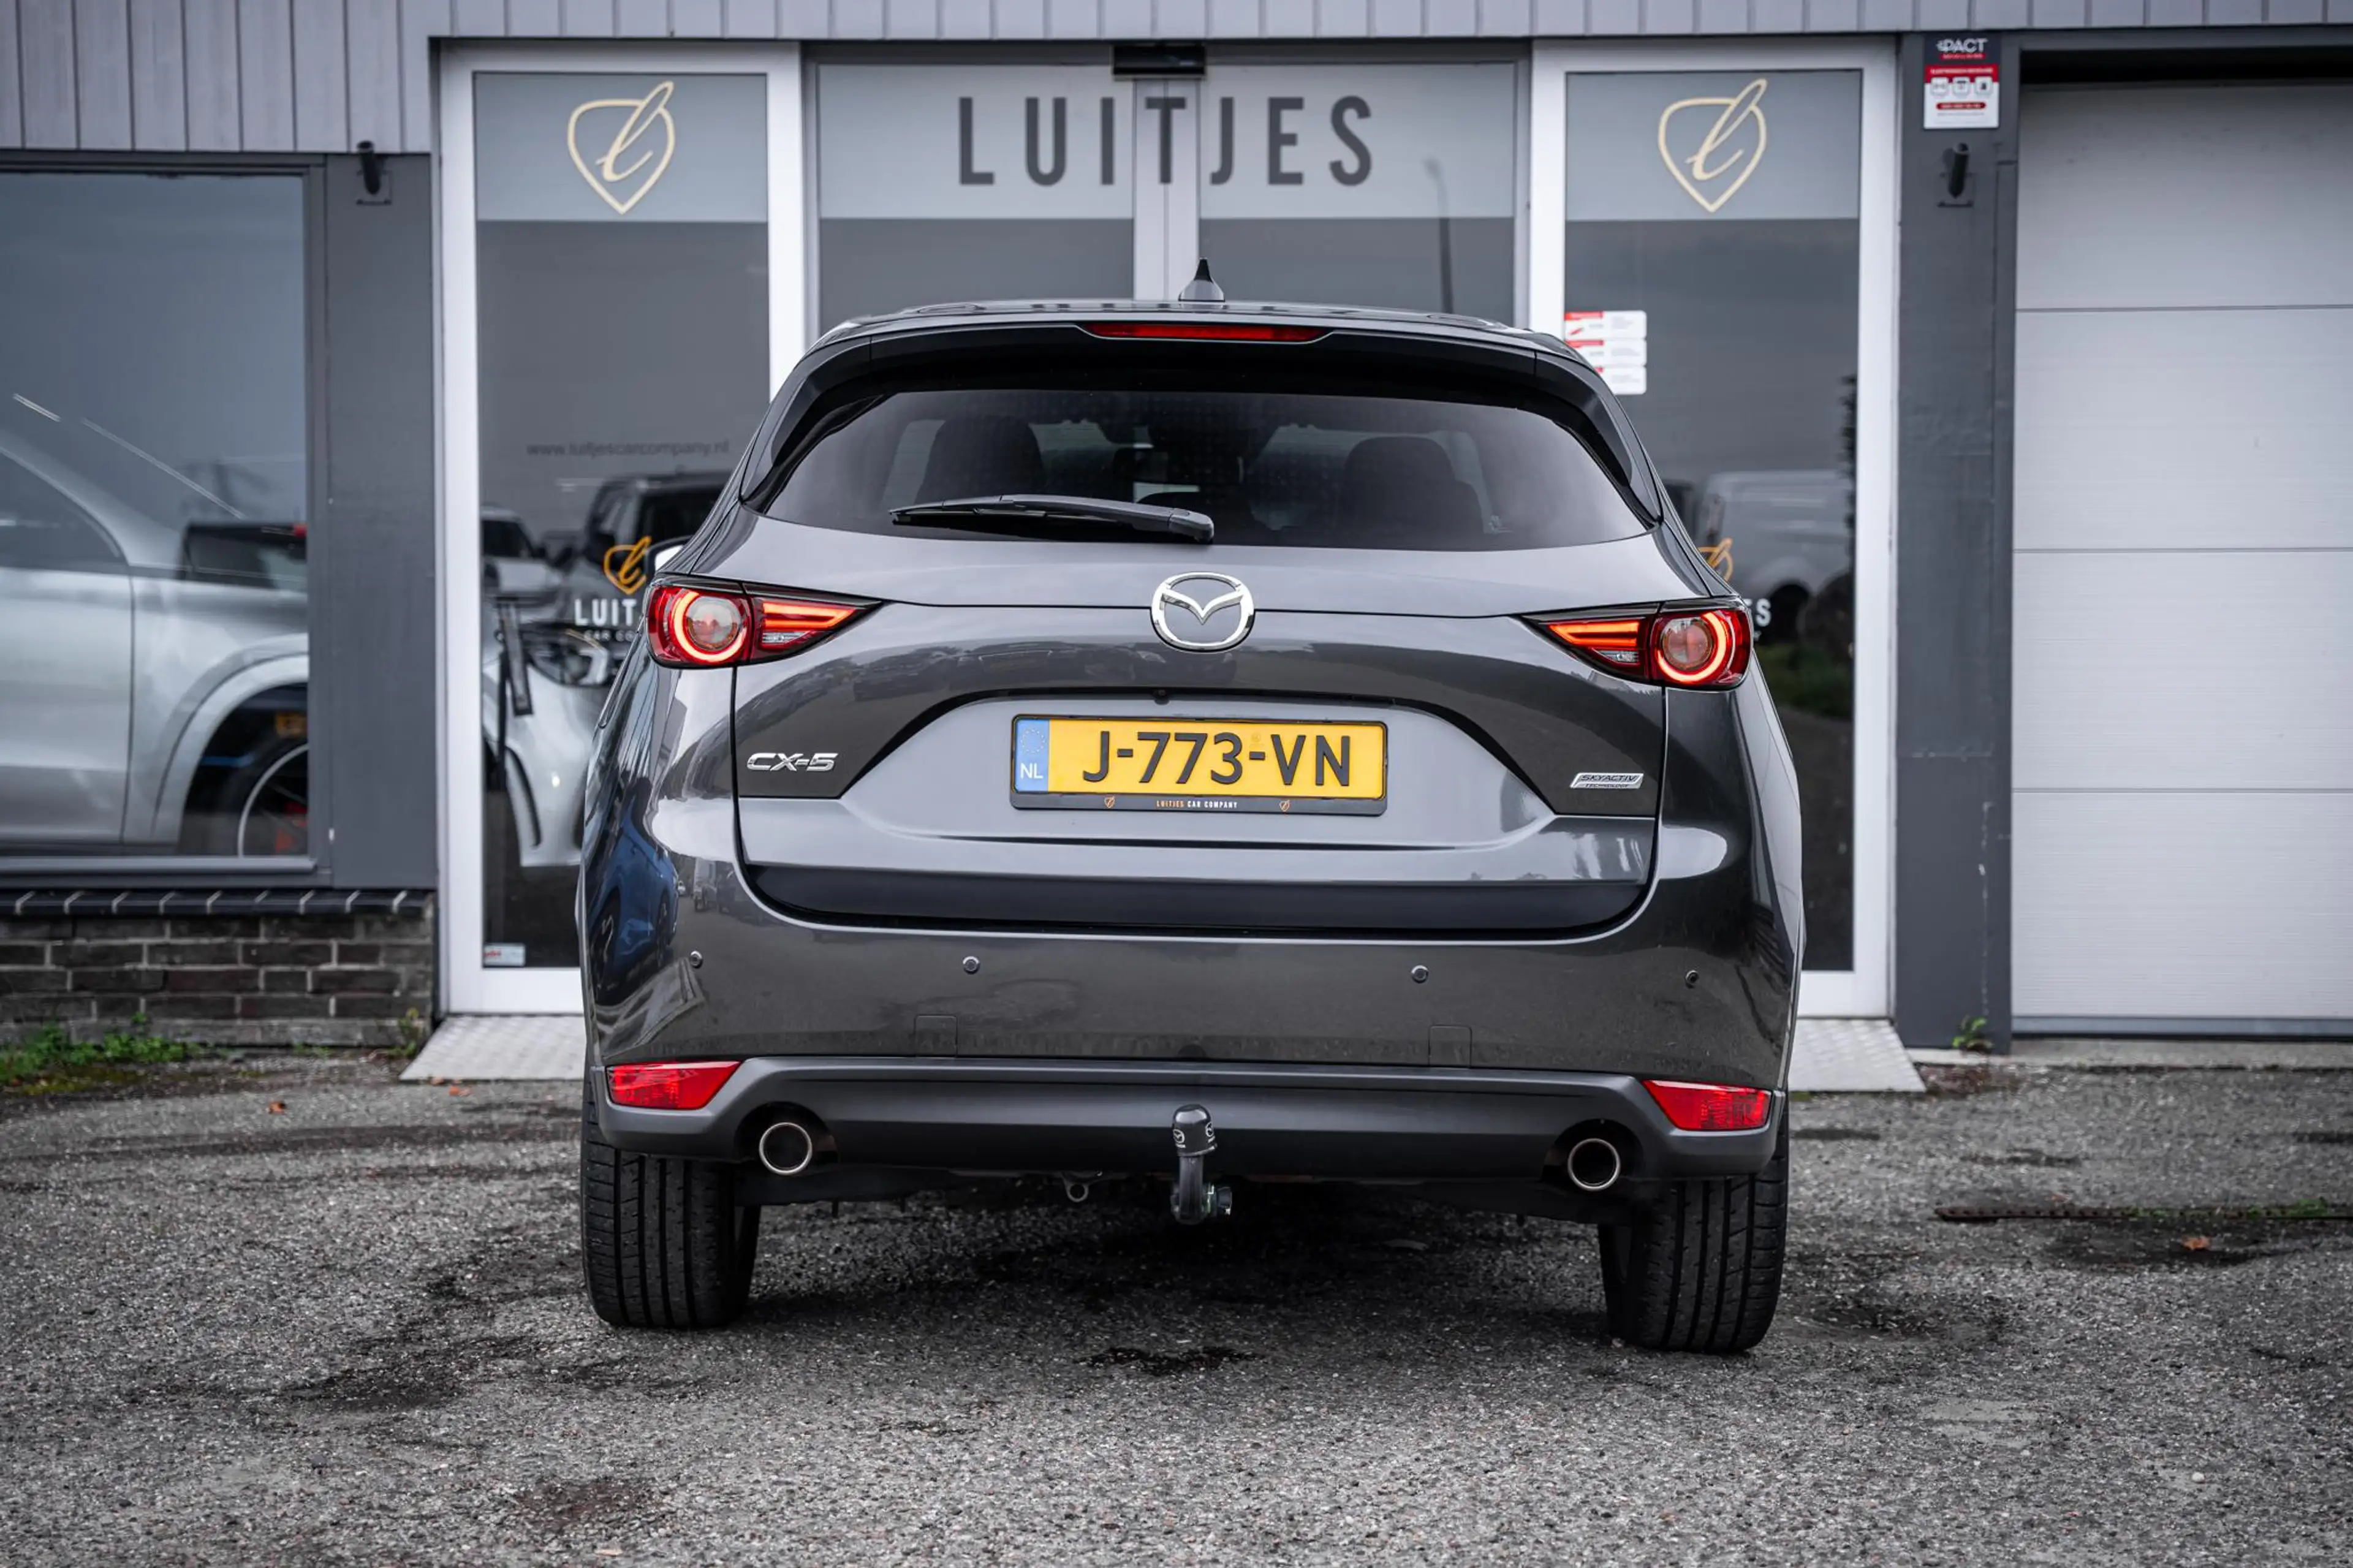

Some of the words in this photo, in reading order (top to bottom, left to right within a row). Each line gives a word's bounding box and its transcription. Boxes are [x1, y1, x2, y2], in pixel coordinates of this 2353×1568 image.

[958, 95, 1372, 186] LUITJES
[575, 598, 637, 627] LUIT
[747, 752, 839, 772] CX-5
[1020, 762, 1044, 779] NL
[1083, 730, 1351, 787] J-773-VN
